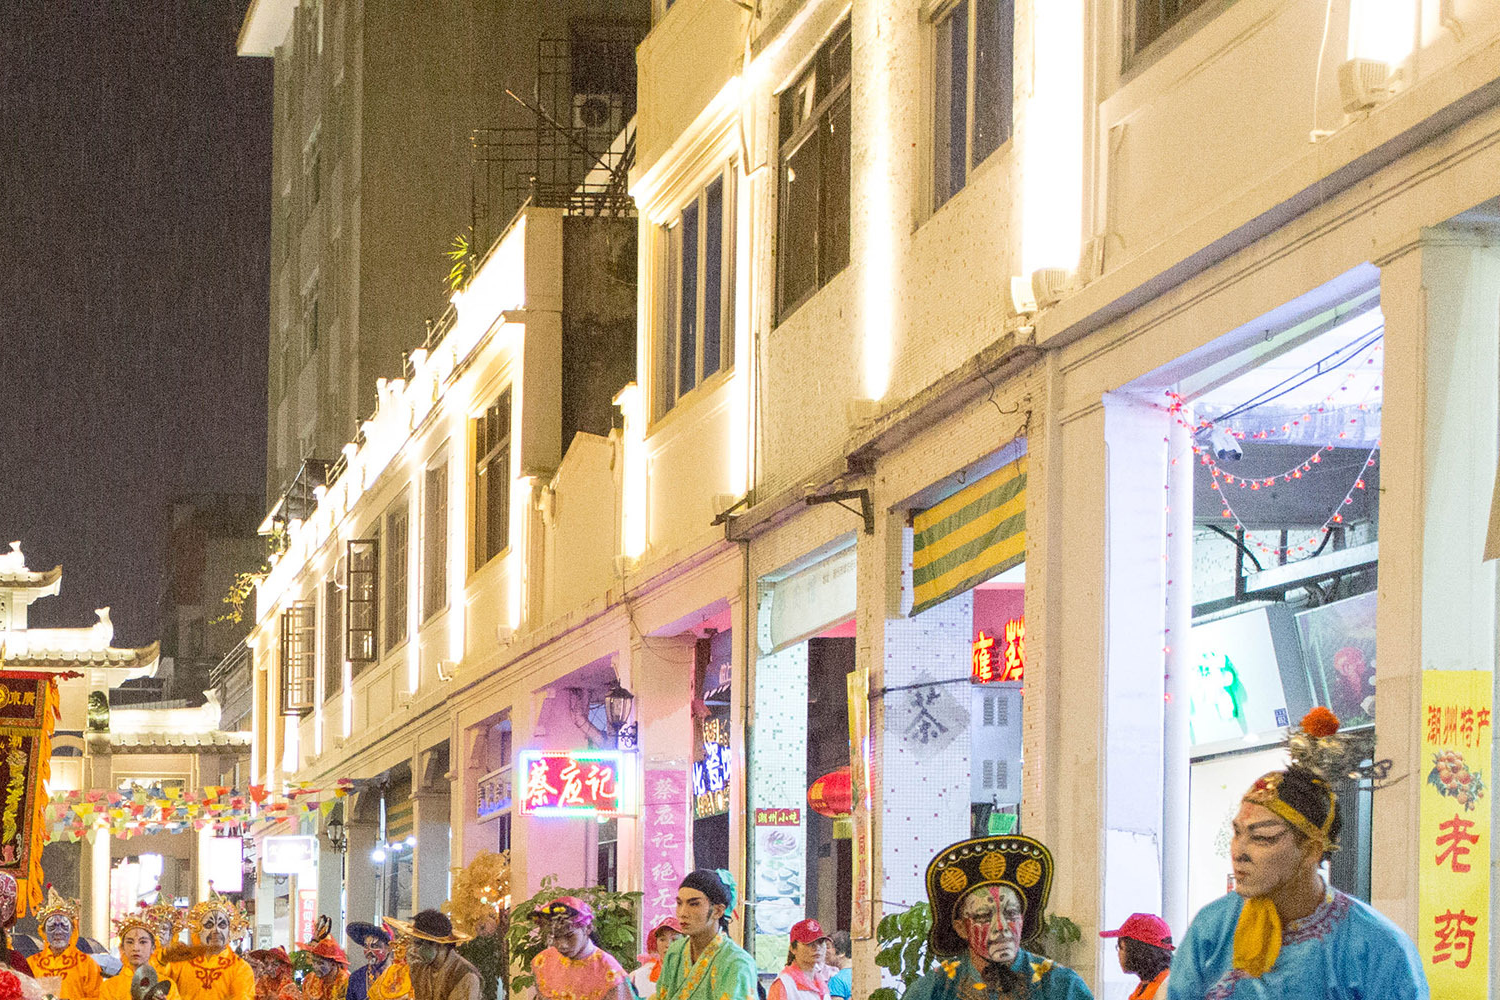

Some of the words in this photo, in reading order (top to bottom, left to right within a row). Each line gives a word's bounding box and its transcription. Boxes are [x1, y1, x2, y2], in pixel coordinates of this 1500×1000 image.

[1428, 705, 1490, 748] 潮州特产
[757, 811, 800, 825] 潮州小吃
